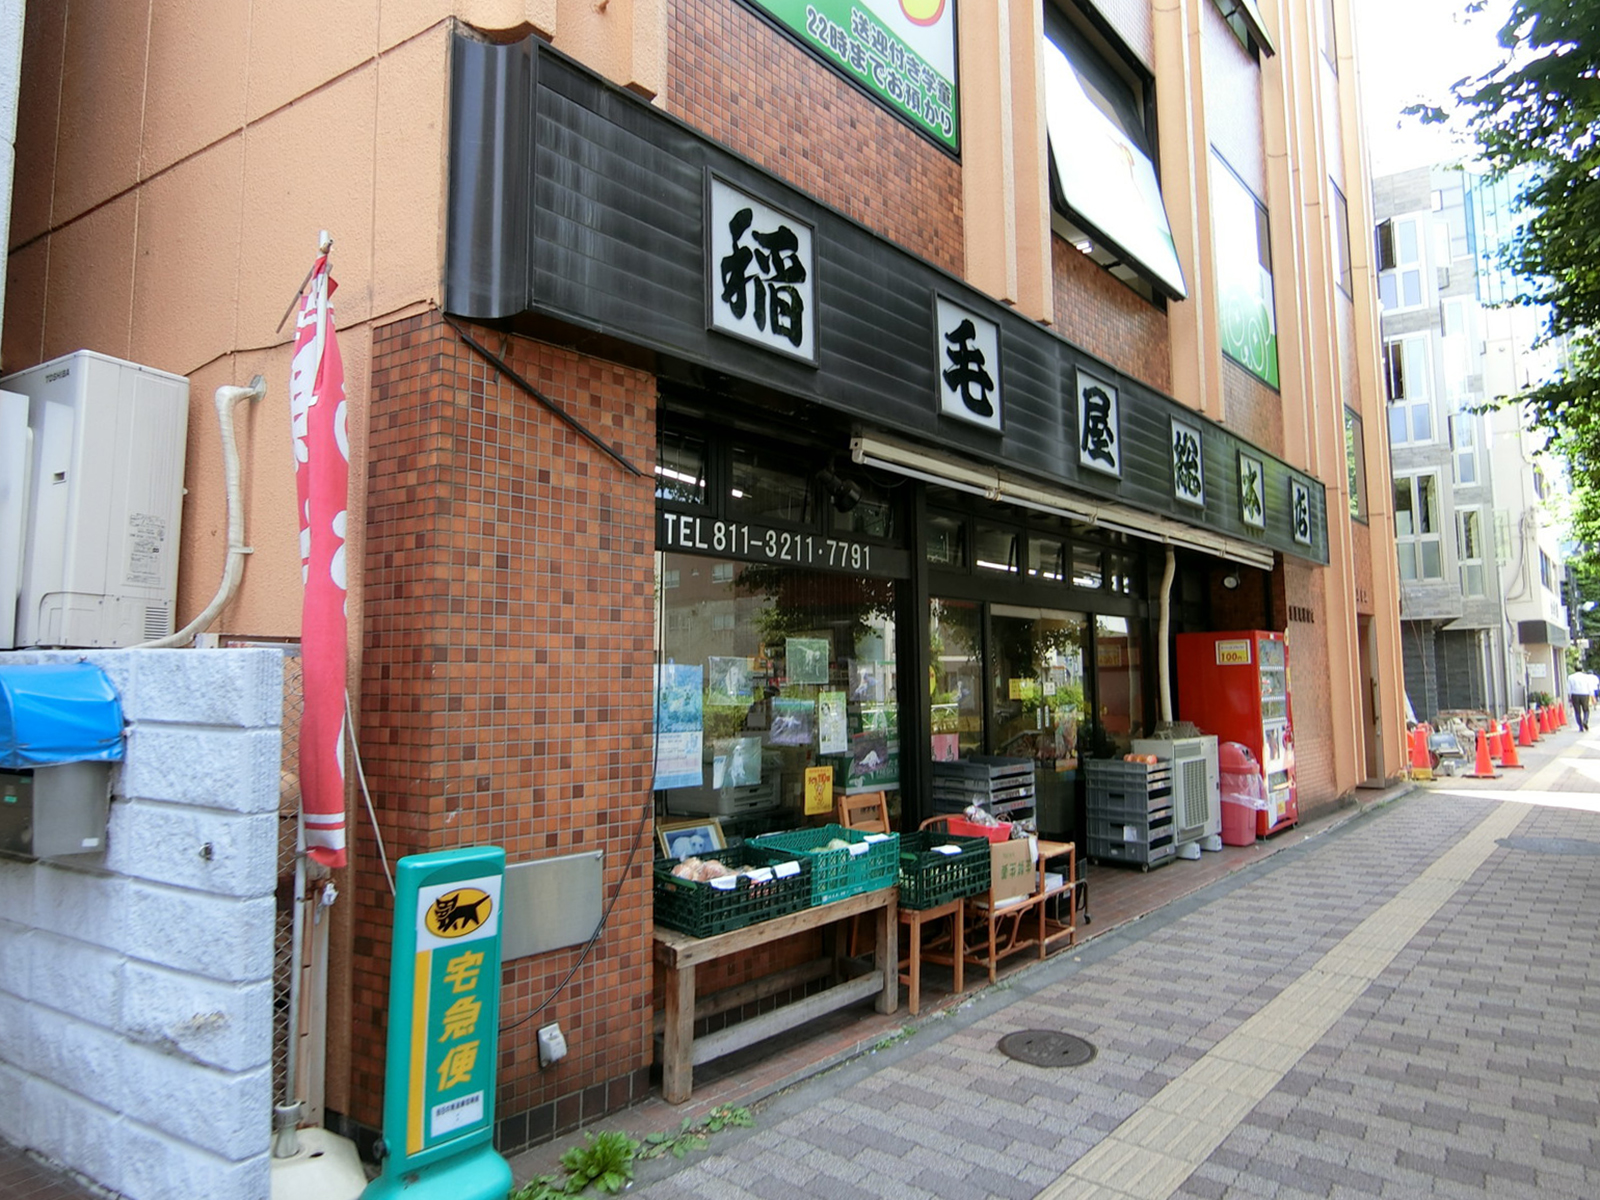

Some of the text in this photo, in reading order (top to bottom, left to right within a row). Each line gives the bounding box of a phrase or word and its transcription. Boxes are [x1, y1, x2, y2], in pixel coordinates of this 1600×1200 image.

[805, 4, 954, 137] 22時までお預かり
[851, 8, 954, 111] 送迎付き学童
[664, 513, 708, 549] TEL
[436, 950, 486, 1092] 宅急便
